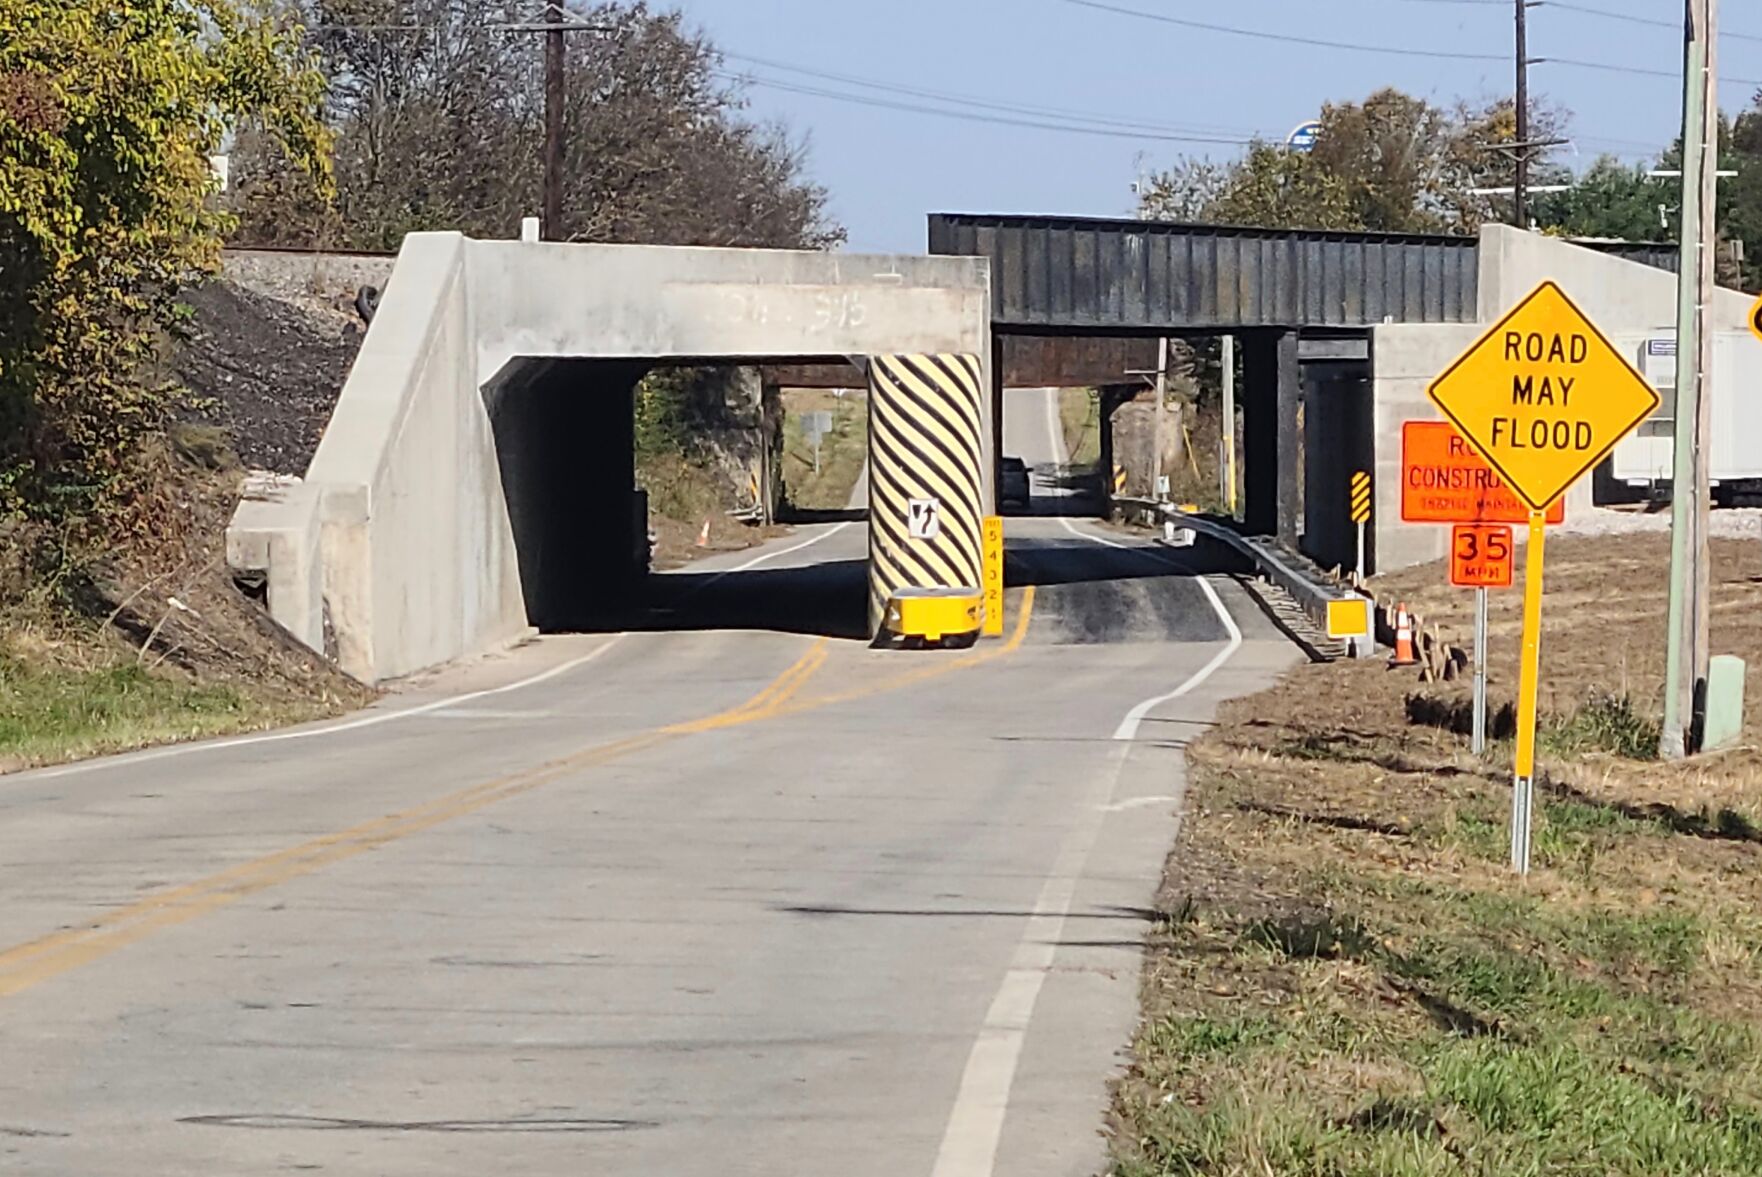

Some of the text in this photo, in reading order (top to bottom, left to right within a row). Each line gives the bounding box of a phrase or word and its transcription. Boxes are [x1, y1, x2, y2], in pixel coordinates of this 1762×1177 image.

[1504, 331, 1587, 364] ROAD
[1512, 375, 1575, 407] MAY
[1491, 417, 1592, 451] FLOOD
[1409, 465, 1509, 488] CONSTRU
[989, 530, 997, 541] 5
[1457, 532, 1508, 561] 35
[989, 549, 997, 561] 4
[989, 589, 997, 600] 2
